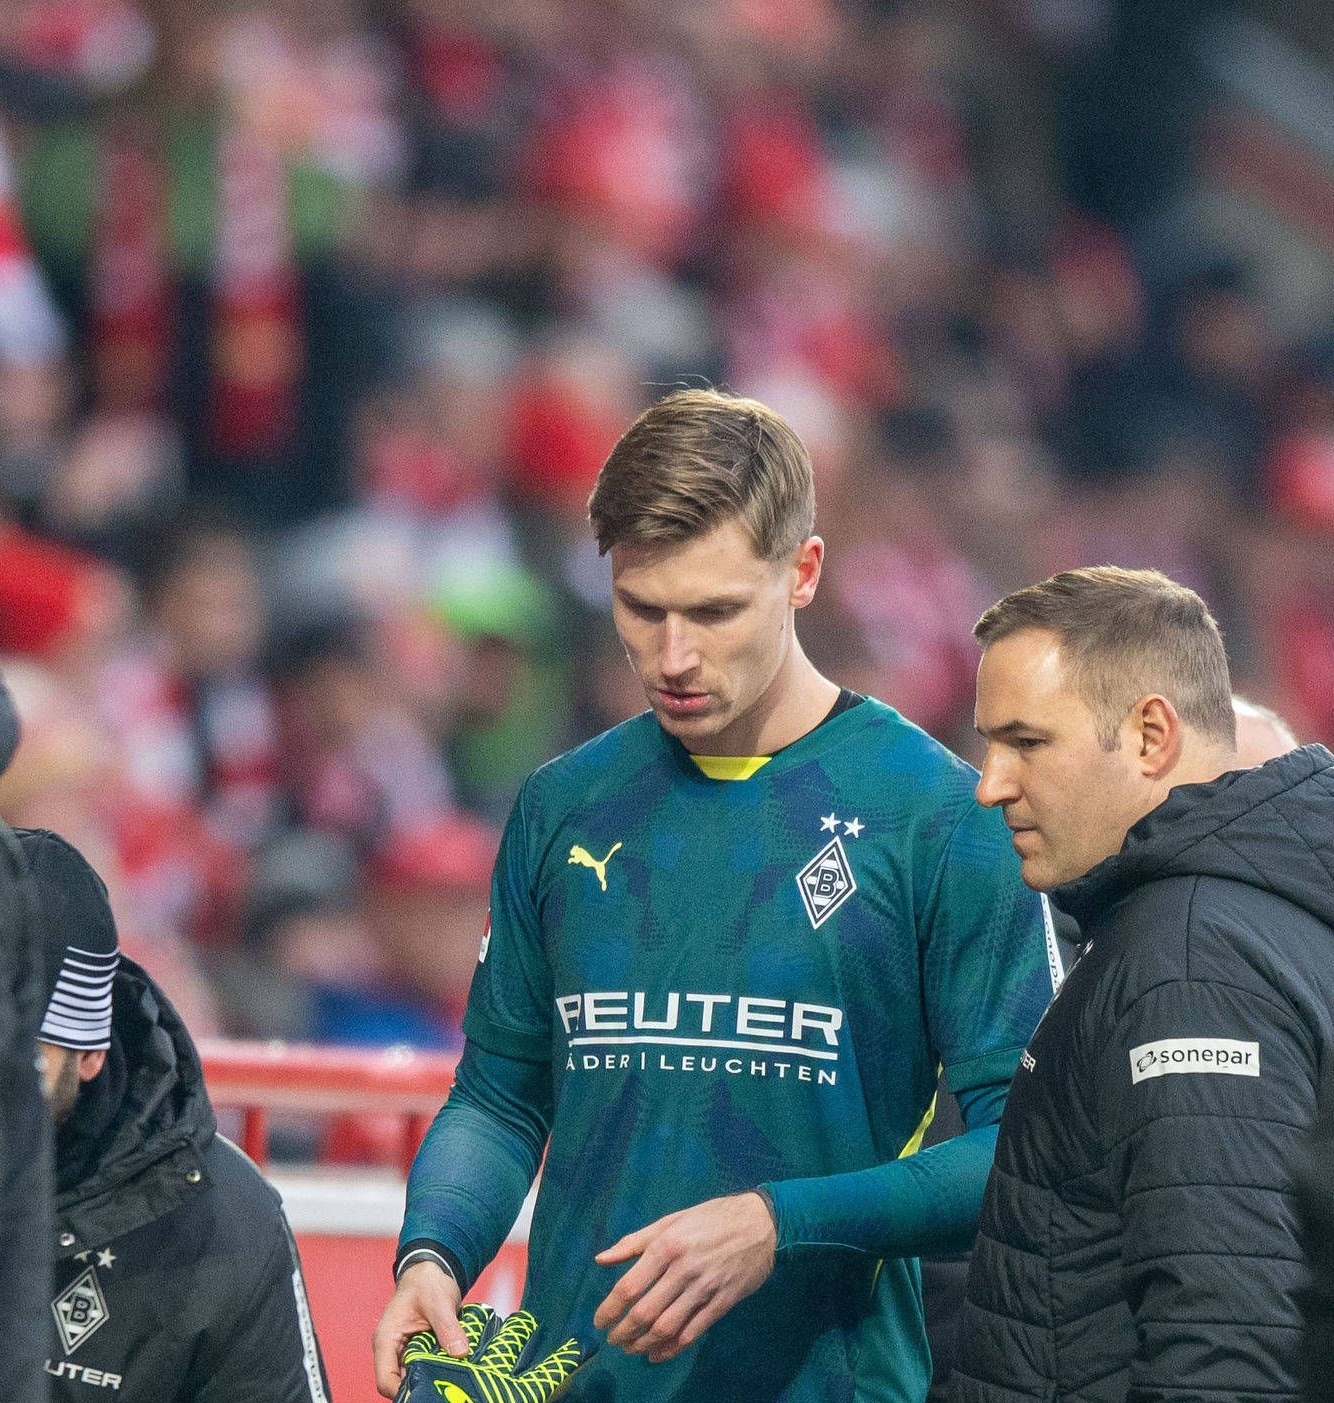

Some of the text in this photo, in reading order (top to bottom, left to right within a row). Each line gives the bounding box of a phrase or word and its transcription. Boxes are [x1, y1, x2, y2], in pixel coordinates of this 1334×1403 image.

[556, 991, 843, 1046] REUTER
[660, 1054, 837, 1086] LEUCHTEN
[1160, 1049, 1252, 1066] sonepar
